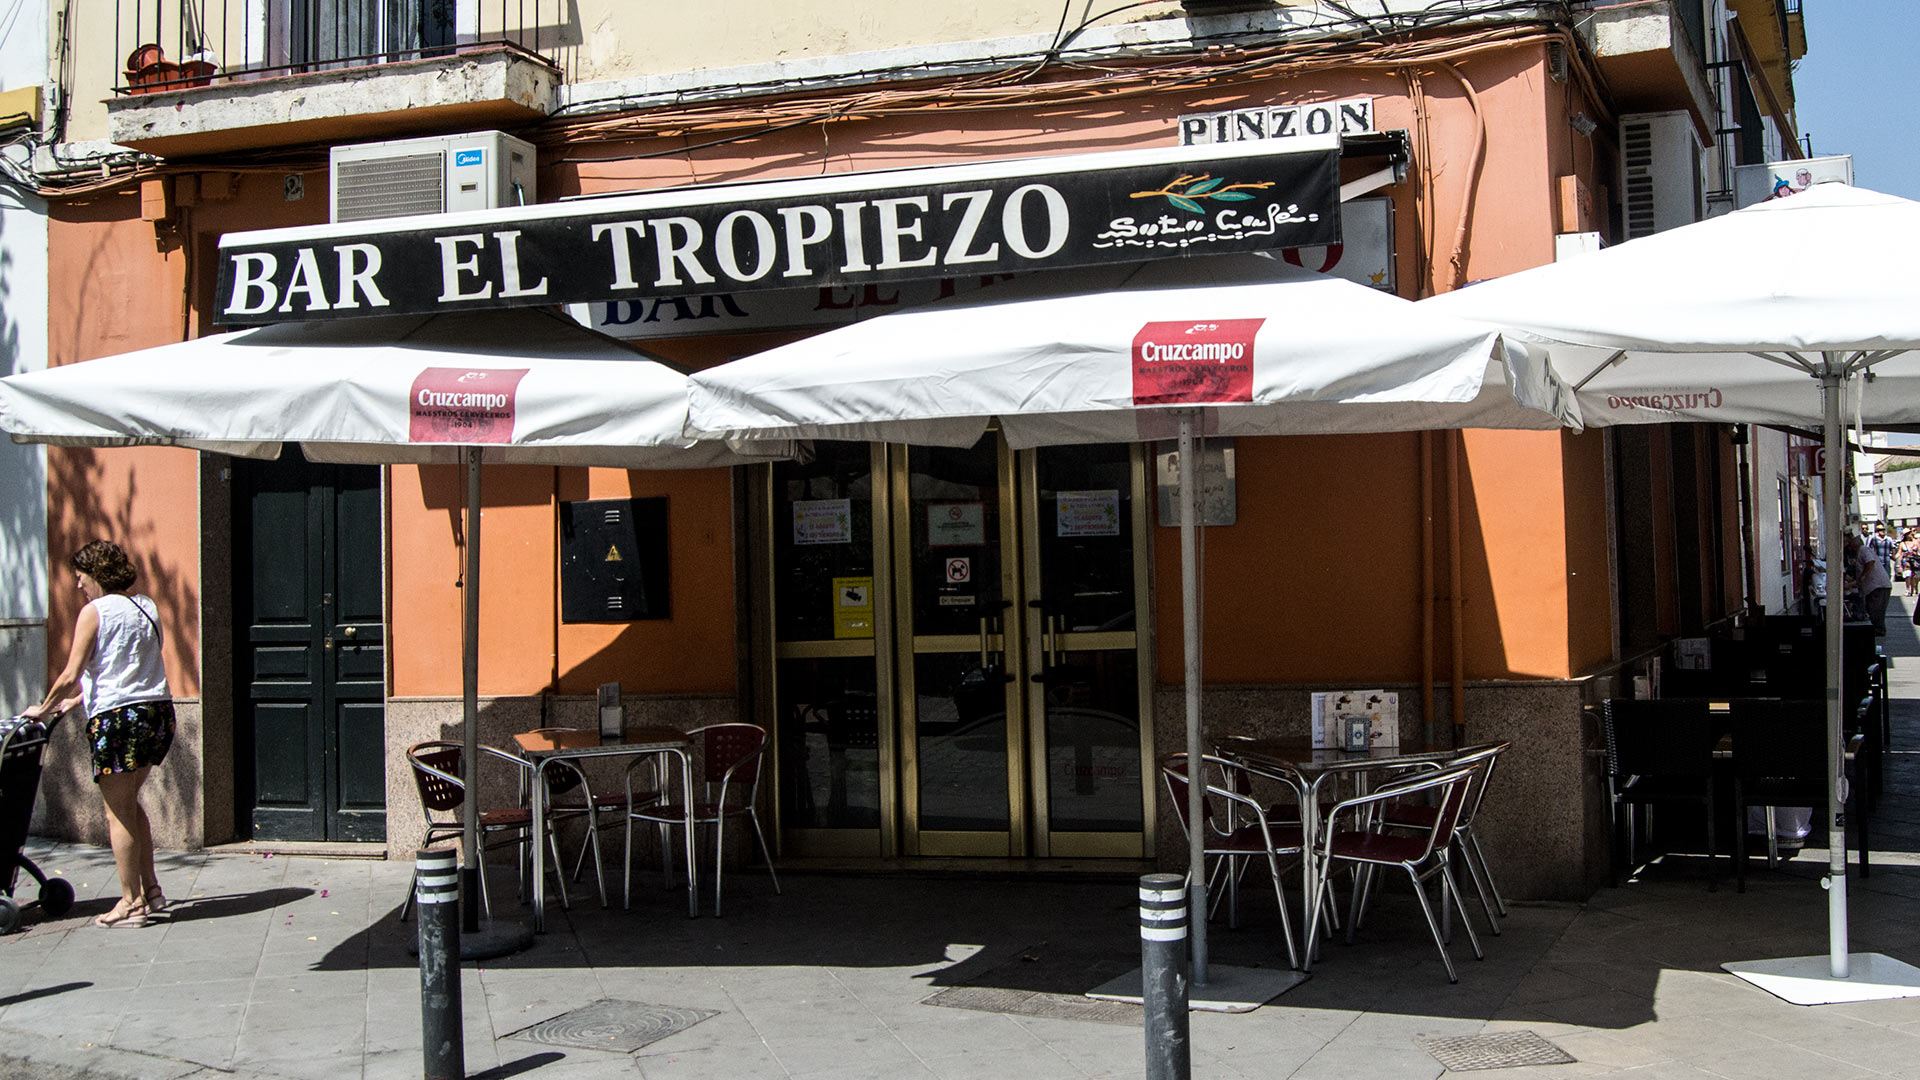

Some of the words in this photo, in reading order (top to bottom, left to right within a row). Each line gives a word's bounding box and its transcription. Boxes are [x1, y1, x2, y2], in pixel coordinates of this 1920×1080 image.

[1183, 102, 1370, 146] PINZON
[224, 243, 390, 316] BAR
[434, 230, 548, 303] EL
[592, 184, 1071, 291] TROPIEZO
[1141, 341, 1245, 364] Cruzcampo
[418, 389, 508, 411] Cruzcampo
[415, 410, 459, 419] MAESTROS
[460, 410, 511, 420] CERVECEROS
